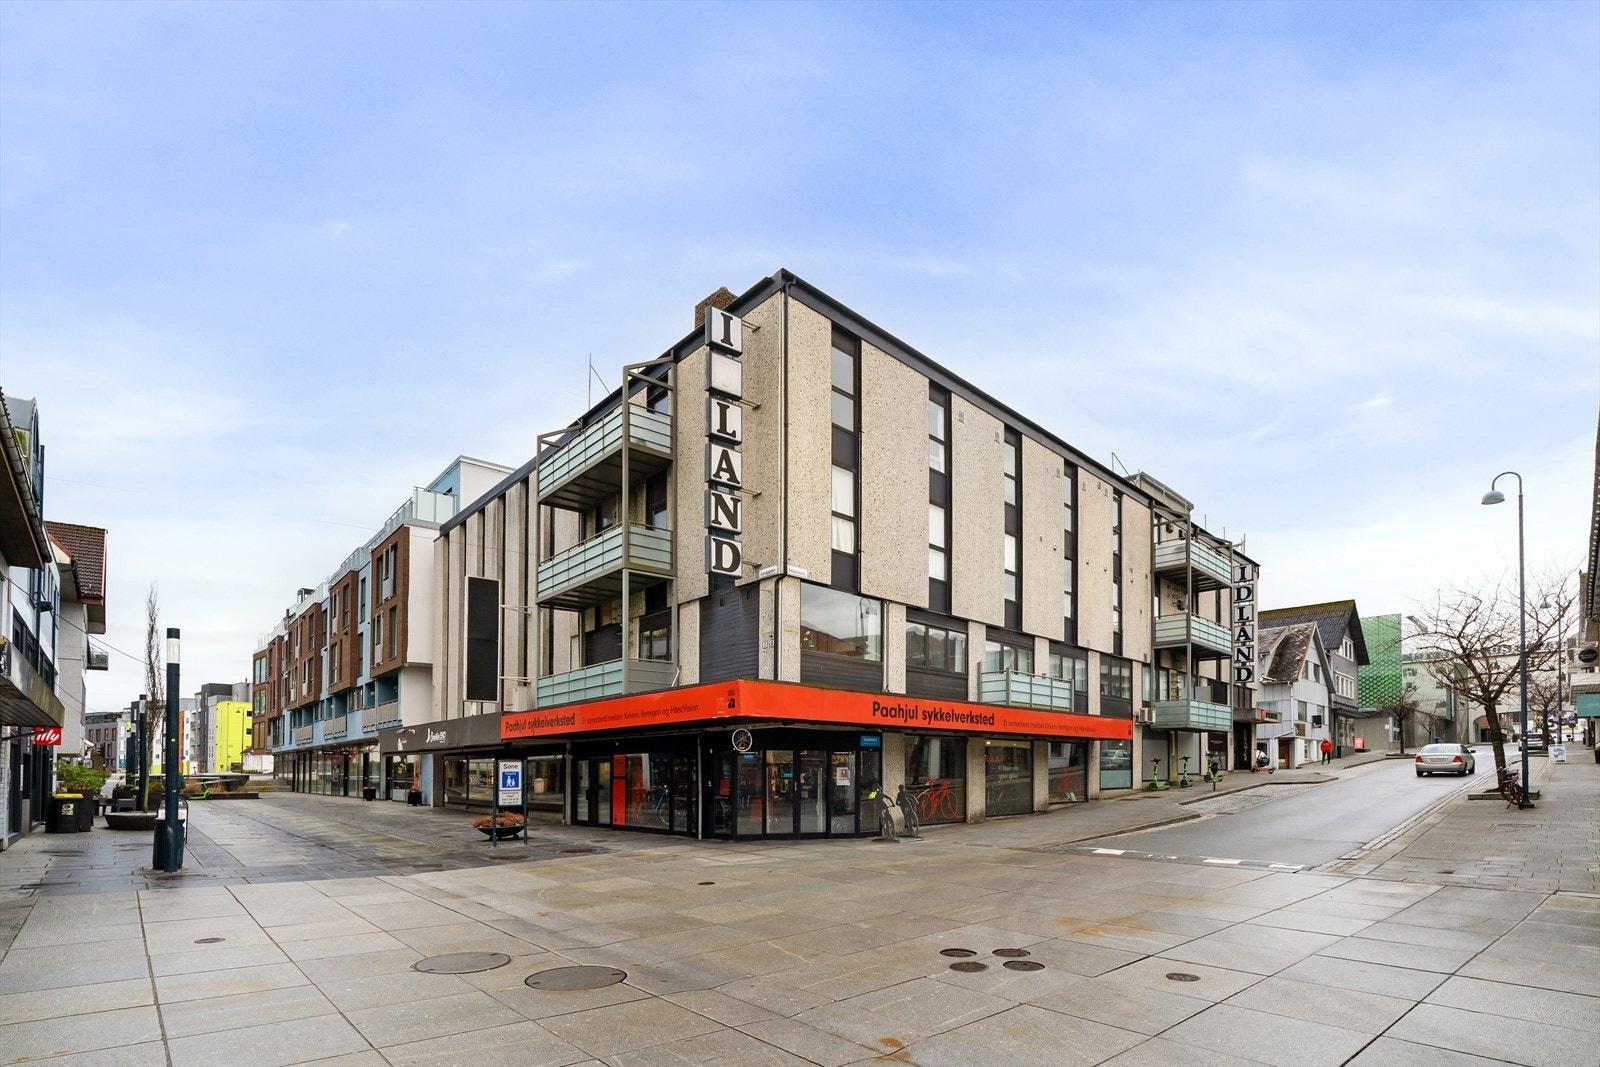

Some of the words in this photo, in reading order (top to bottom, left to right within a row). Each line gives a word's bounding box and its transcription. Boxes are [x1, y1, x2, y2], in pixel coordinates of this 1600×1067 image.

[711, 312, 742, 573] ILAND
[1235, 566, 1253, 682] IDLAND
[505, 719, 526, 733] Paahjul
[528, 713, 576, 733] sykkelverksted
[872, 701, 918, 723] Paahjul
[922, 707, 995, 726] sykkelverksted
[36, 728, 60, 744] illy
